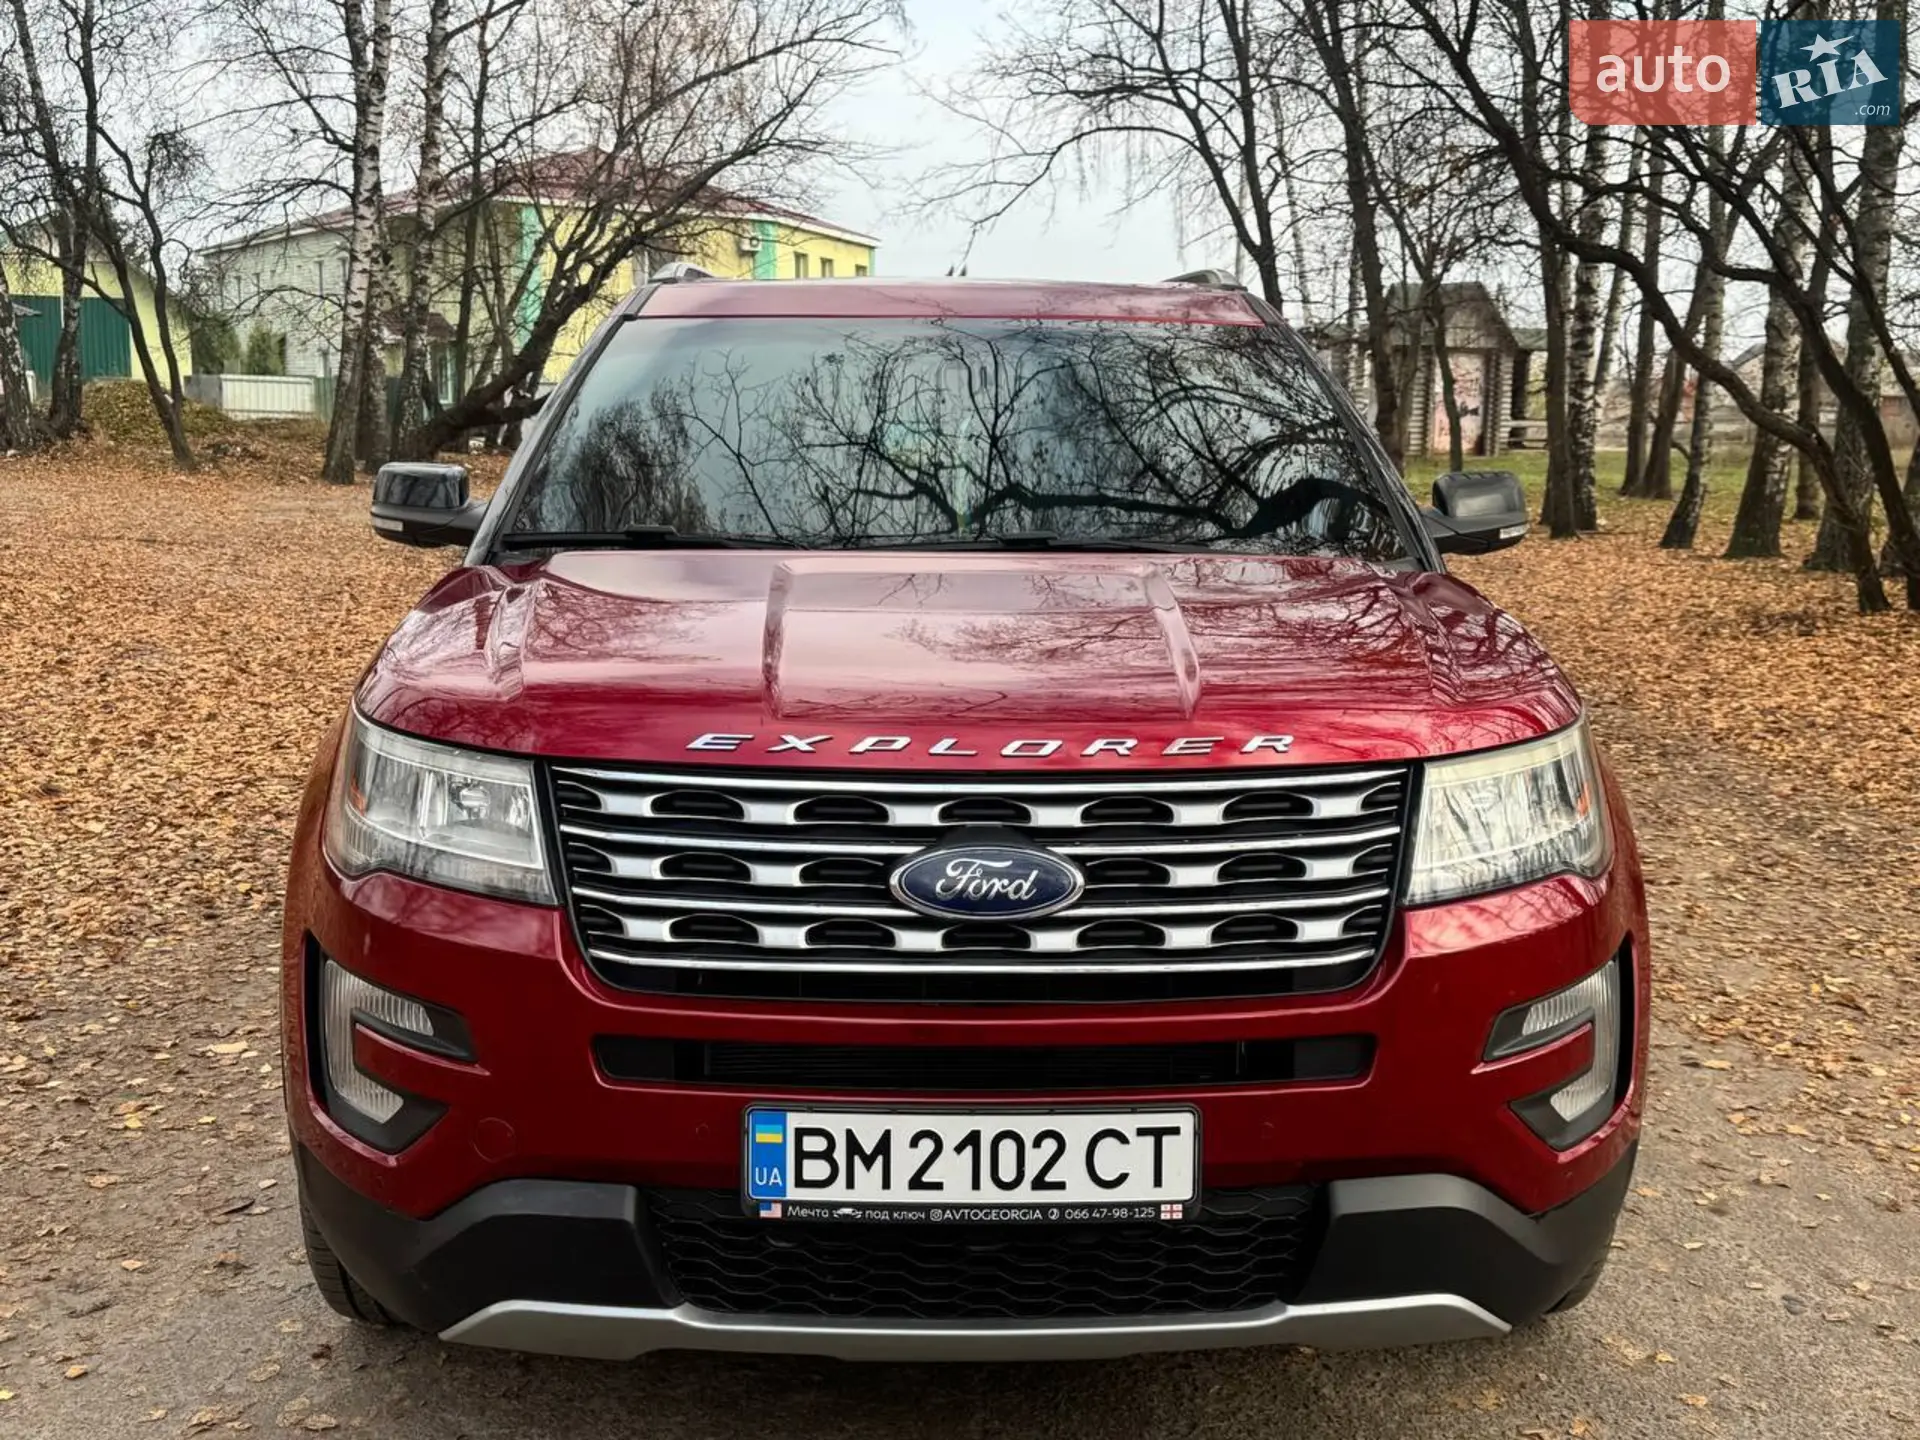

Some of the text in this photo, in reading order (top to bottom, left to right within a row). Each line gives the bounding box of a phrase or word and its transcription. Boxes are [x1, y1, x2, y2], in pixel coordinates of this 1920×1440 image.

[685, 732, 1296, 758] EXPLORER
[935, 858, 1039, 901] Ford
[793, 1126, 1181, 1192] BM 2102 CT
[754, 1167, 782, 1187] UA
[786, 1205, 829, 1218] Мечта
[865, 1209, 890, 1221] под
[893, 1209, 926, 1221] ключ
[1064, 1208, 1089, 1220] 066
[1091, 1207, 1155, 1219] 47-98-125
